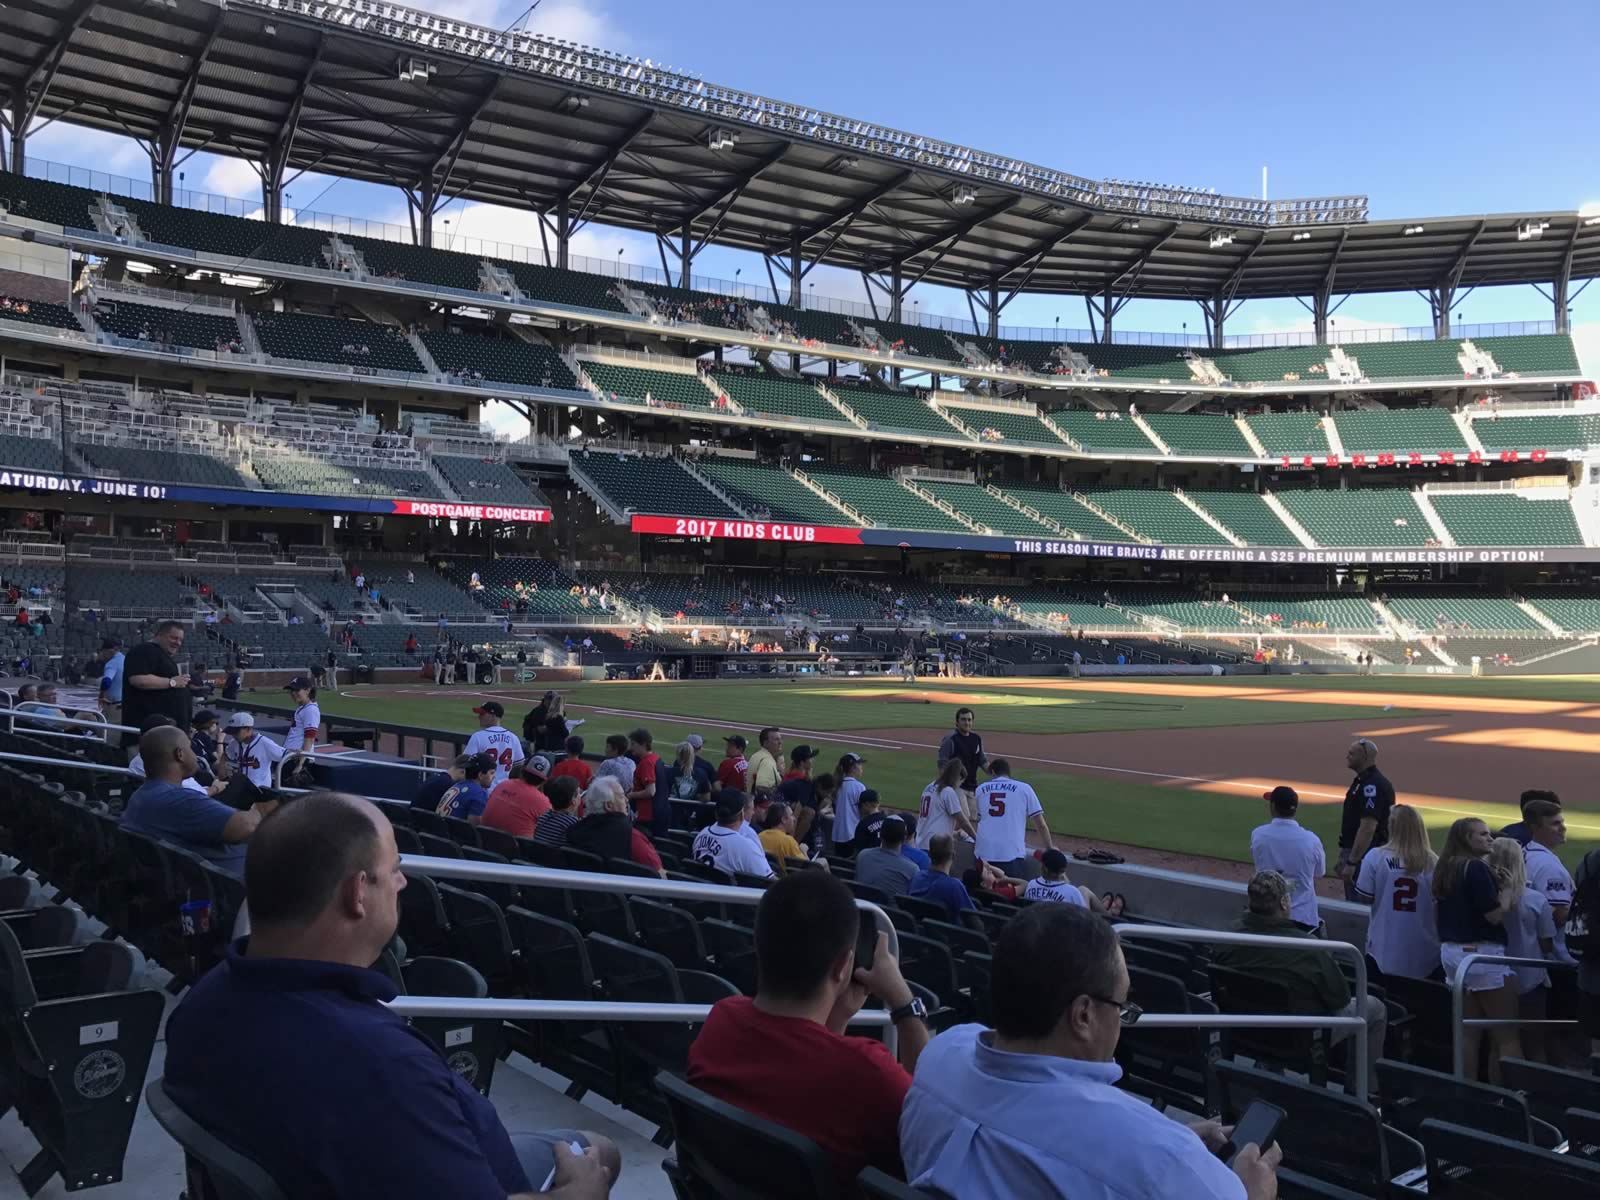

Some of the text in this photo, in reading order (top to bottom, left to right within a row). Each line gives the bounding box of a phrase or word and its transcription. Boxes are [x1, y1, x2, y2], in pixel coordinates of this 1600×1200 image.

[92, 481, 138, 497] JUNE
[143, 486, 166, 499] 10!
[411, 502, 545, 522] POSTGAME CONCERT
[676, 519, 815, 541] 2017 KIDS CLUB
[1014, 540, 1546, 562] THIS SEASON THE BRAVES ARE OFFERING A $25 PREMIUM MEMBERSHIP OPTION!
[487, 734, 511, 745] GATTIS
[981, 783, 1018, 794] FREEMAN
[988, 792, 1006, 817] 5
[697, 836, 722, 856] JONES
[1027, 887, 1065, 903] FREEMAN
[1392, 876, 1418, 913] 2
[95, 1026, 103, 1039] 9
[455, 1031, 463, 1042] 8
